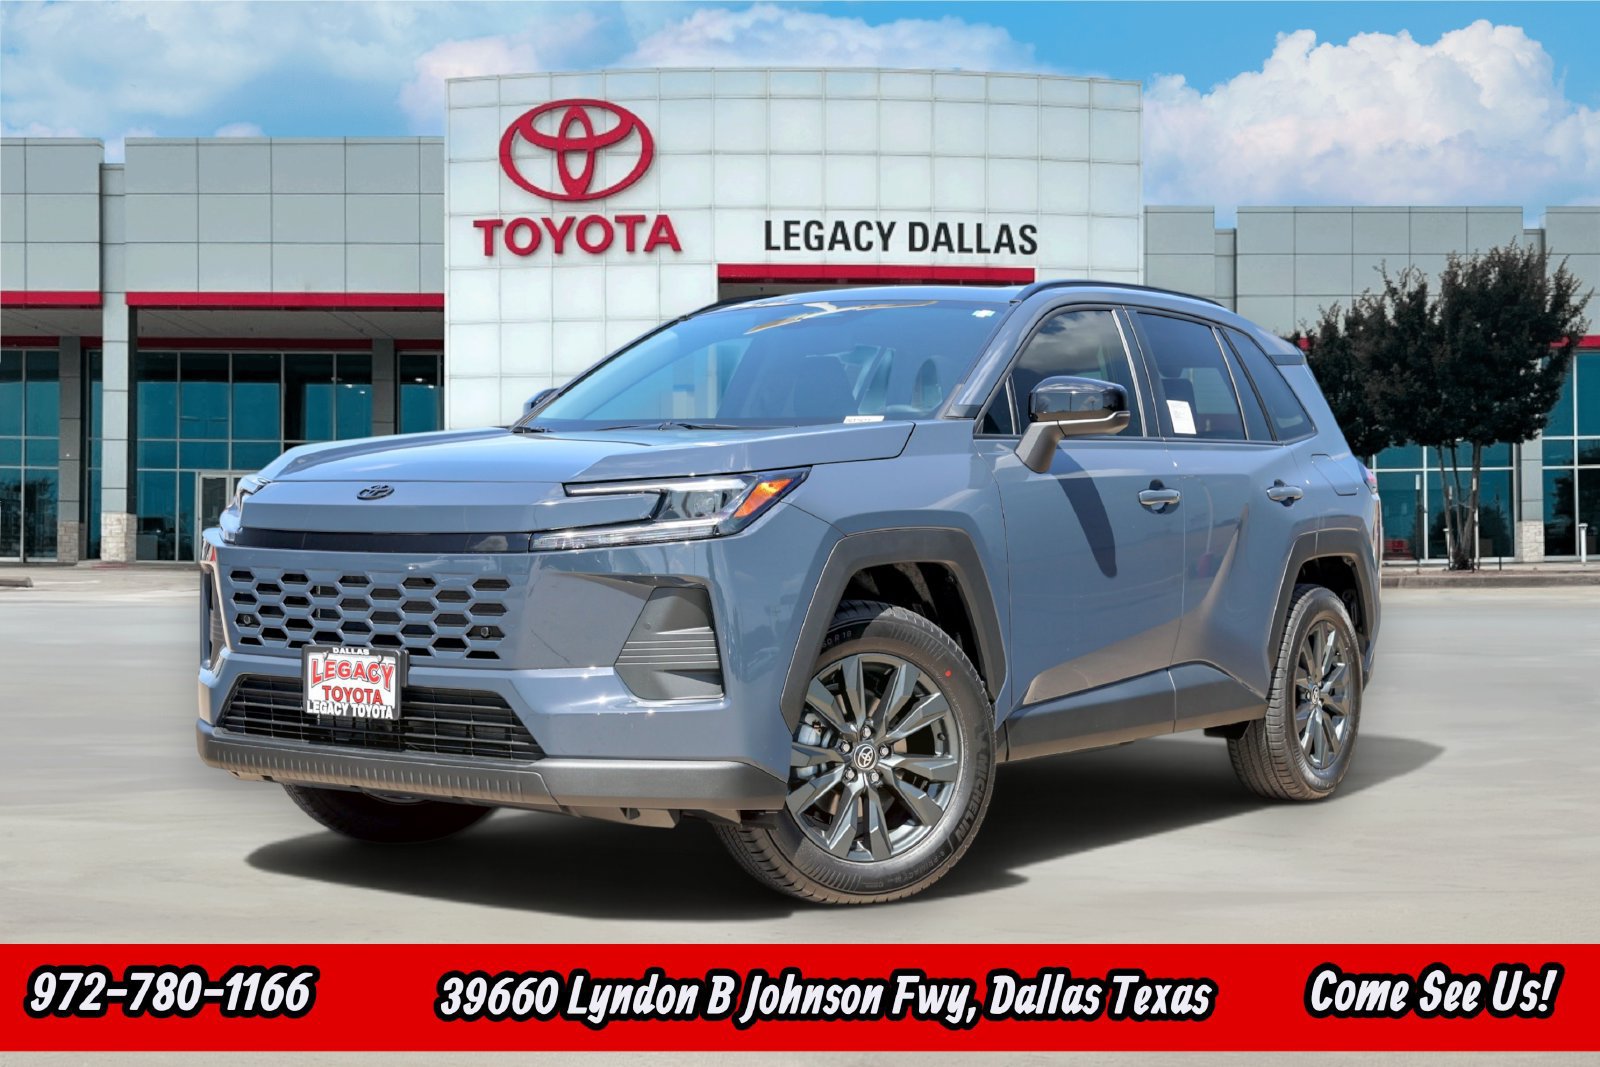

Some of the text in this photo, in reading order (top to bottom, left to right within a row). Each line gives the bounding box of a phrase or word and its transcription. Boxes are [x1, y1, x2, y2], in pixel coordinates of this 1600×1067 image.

[474, 214, 682, 257] TOYOTA
[765, 220, 1038, 255] LEGACY DALLAS
[332, 646, 370, 656] DALLAS
[311, 659, 395, 692] LEGACY
[306, 699, 394, 720] LEGACY TOYOTA
[322, 685, 384, 706] TOYOTA
[954, 752, 990, 842] MICHELIN
